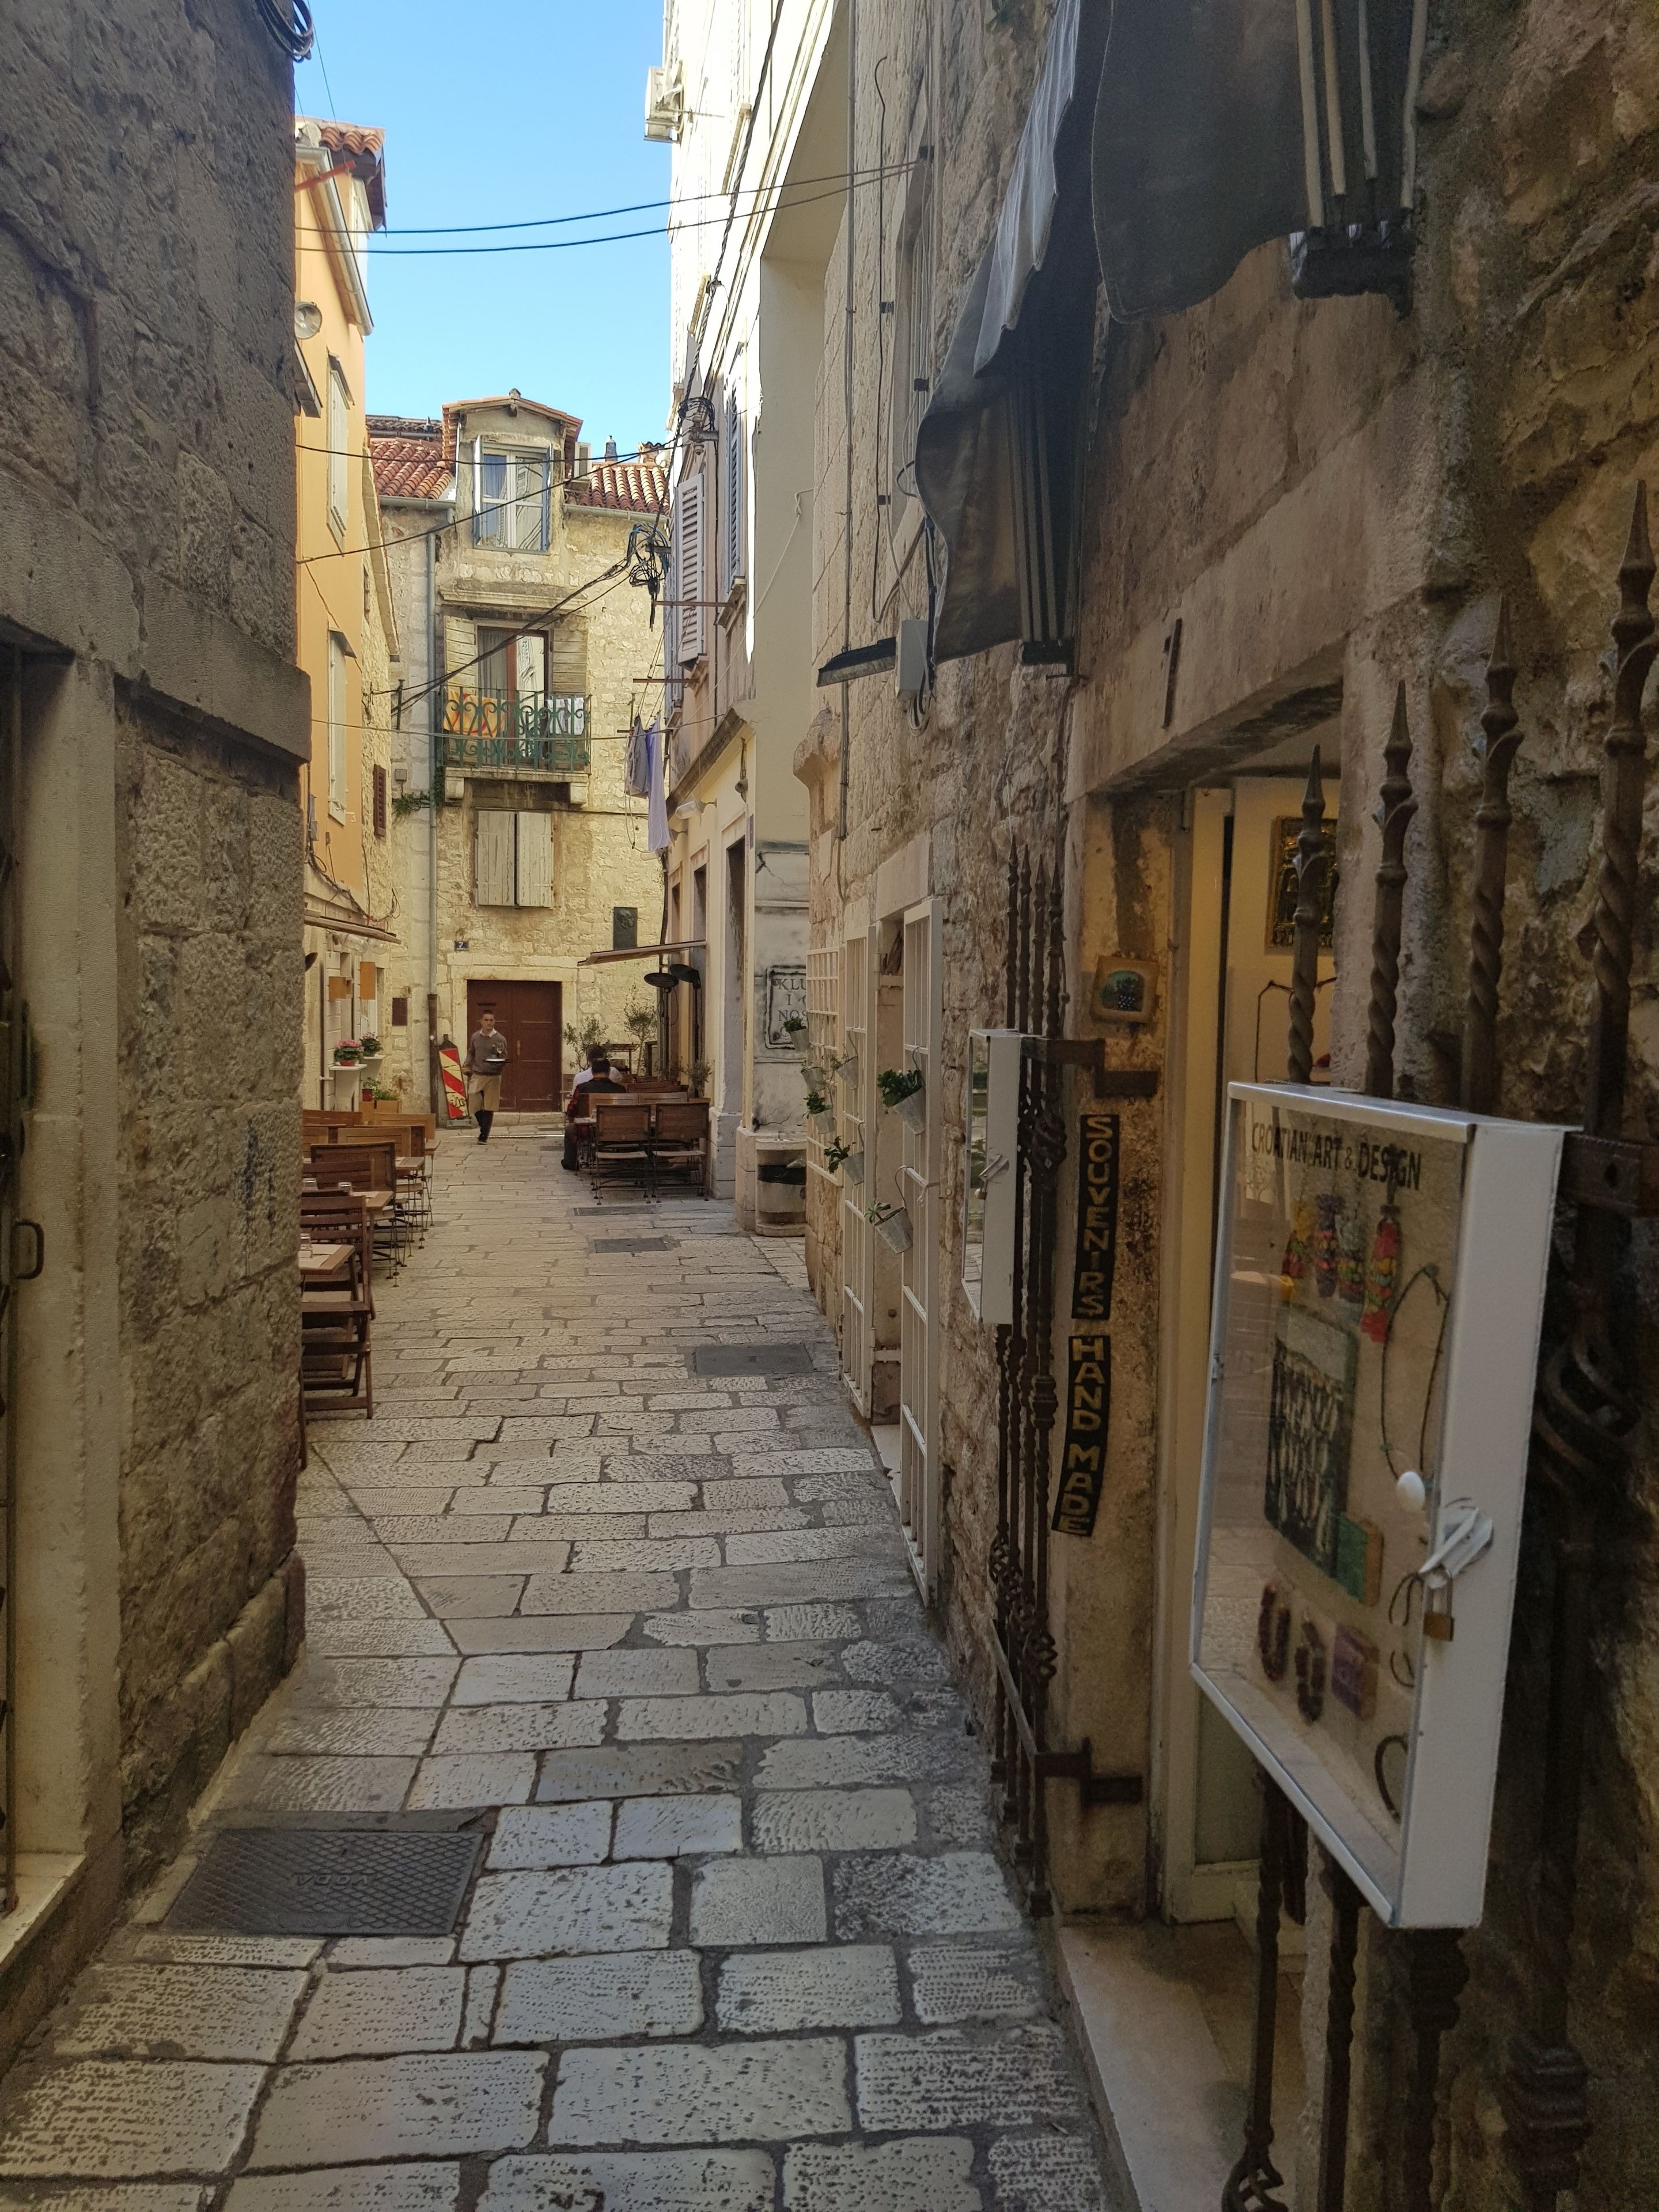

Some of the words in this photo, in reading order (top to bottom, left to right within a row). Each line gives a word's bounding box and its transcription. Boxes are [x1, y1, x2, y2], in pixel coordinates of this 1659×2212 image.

[1251, 1122, 1308, 1162] CROATIAN
[1313, 1134, 1342, 1171] ART
[1344, 1146, 1353, 1170] &
[1077, 1116, 1113, 1316] SOUVENIRS
[1072, 1338, 1105, 1431] HAND
[1058, 1443, 1101, 1535] MADE
[298, 1873, 369, 1886] VODA
